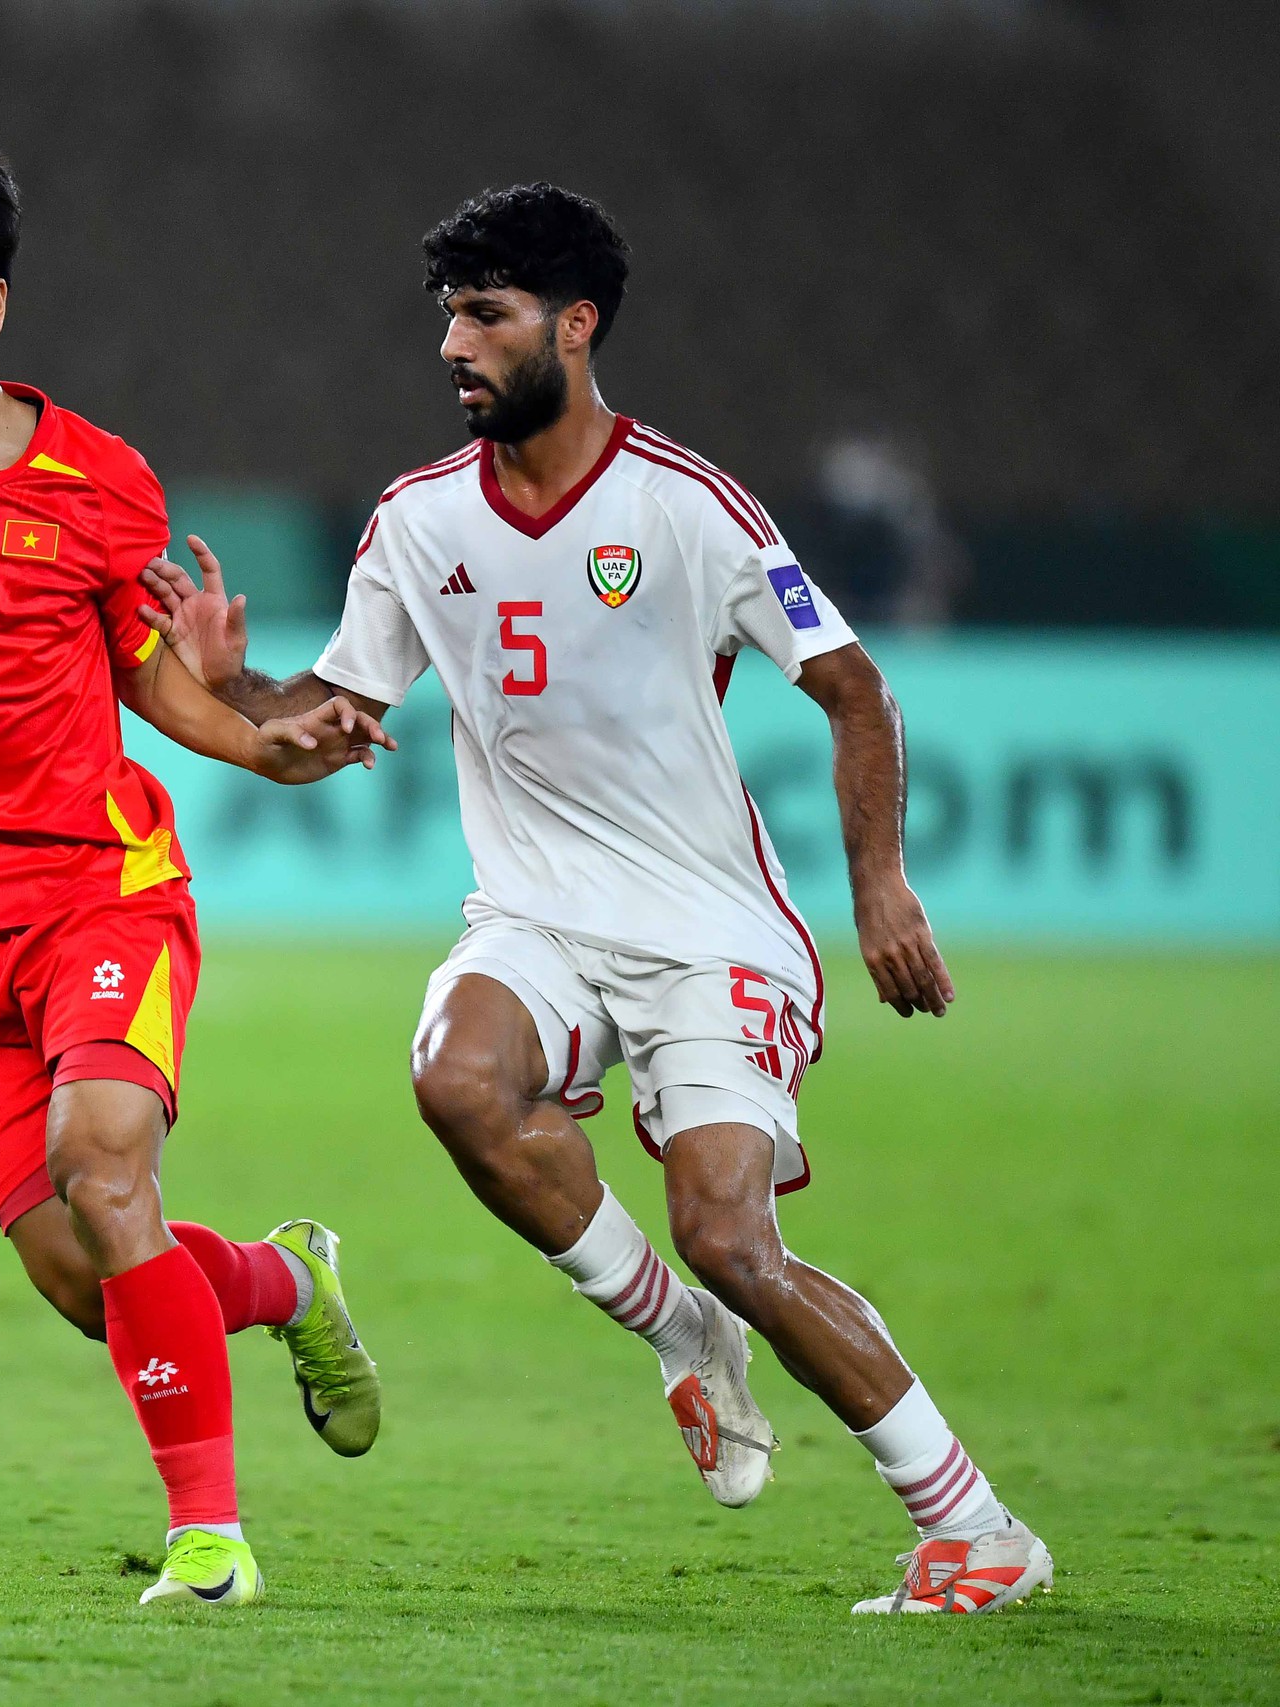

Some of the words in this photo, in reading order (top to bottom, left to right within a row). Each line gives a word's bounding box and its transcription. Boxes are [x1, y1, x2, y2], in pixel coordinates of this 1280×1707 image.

[602, 562, 627, 571] UAE
[608, 572, 622, 580] FA
[783, 584, 809, 606] AFC
[497, 601, 548, 696] 5
[728, 965, 776, 1042] 5
